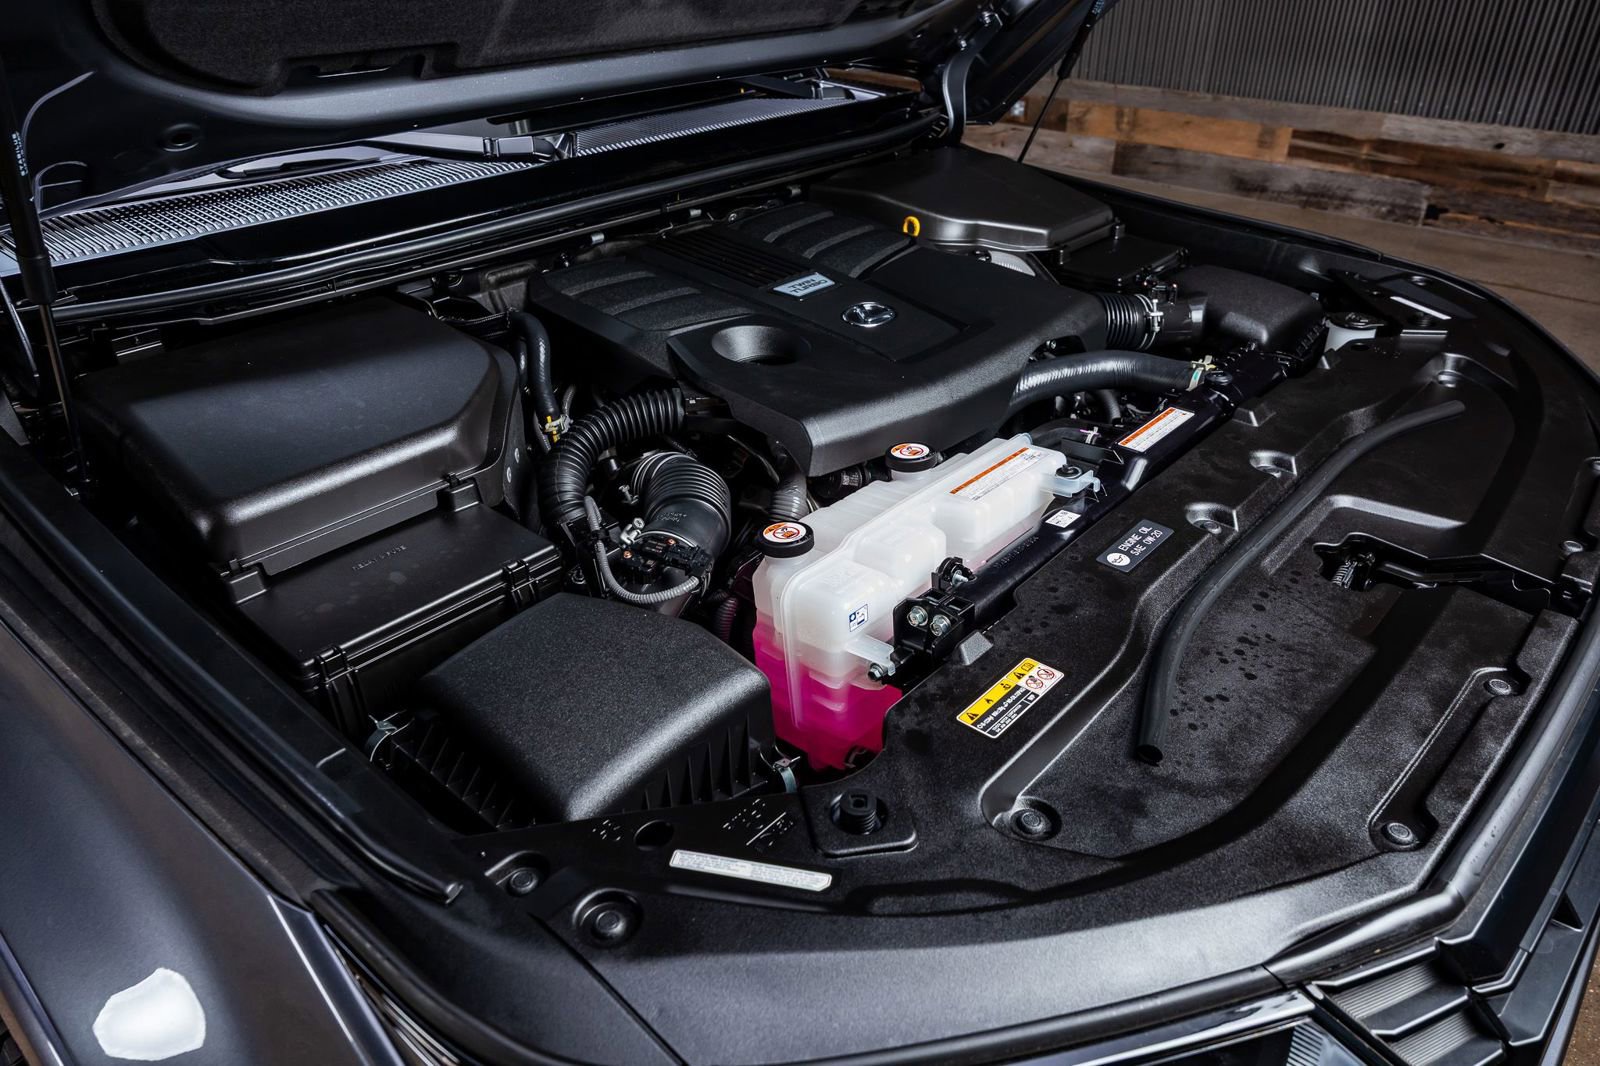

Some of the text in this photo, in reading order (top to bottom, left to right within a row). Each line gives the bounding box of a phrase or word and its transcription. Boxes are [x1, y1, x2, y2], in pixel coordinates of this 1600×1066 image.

[1117, 526, 1153, 552] ENGINE OIL
[1130, 529, 1163, 556] SAE 0W-20
